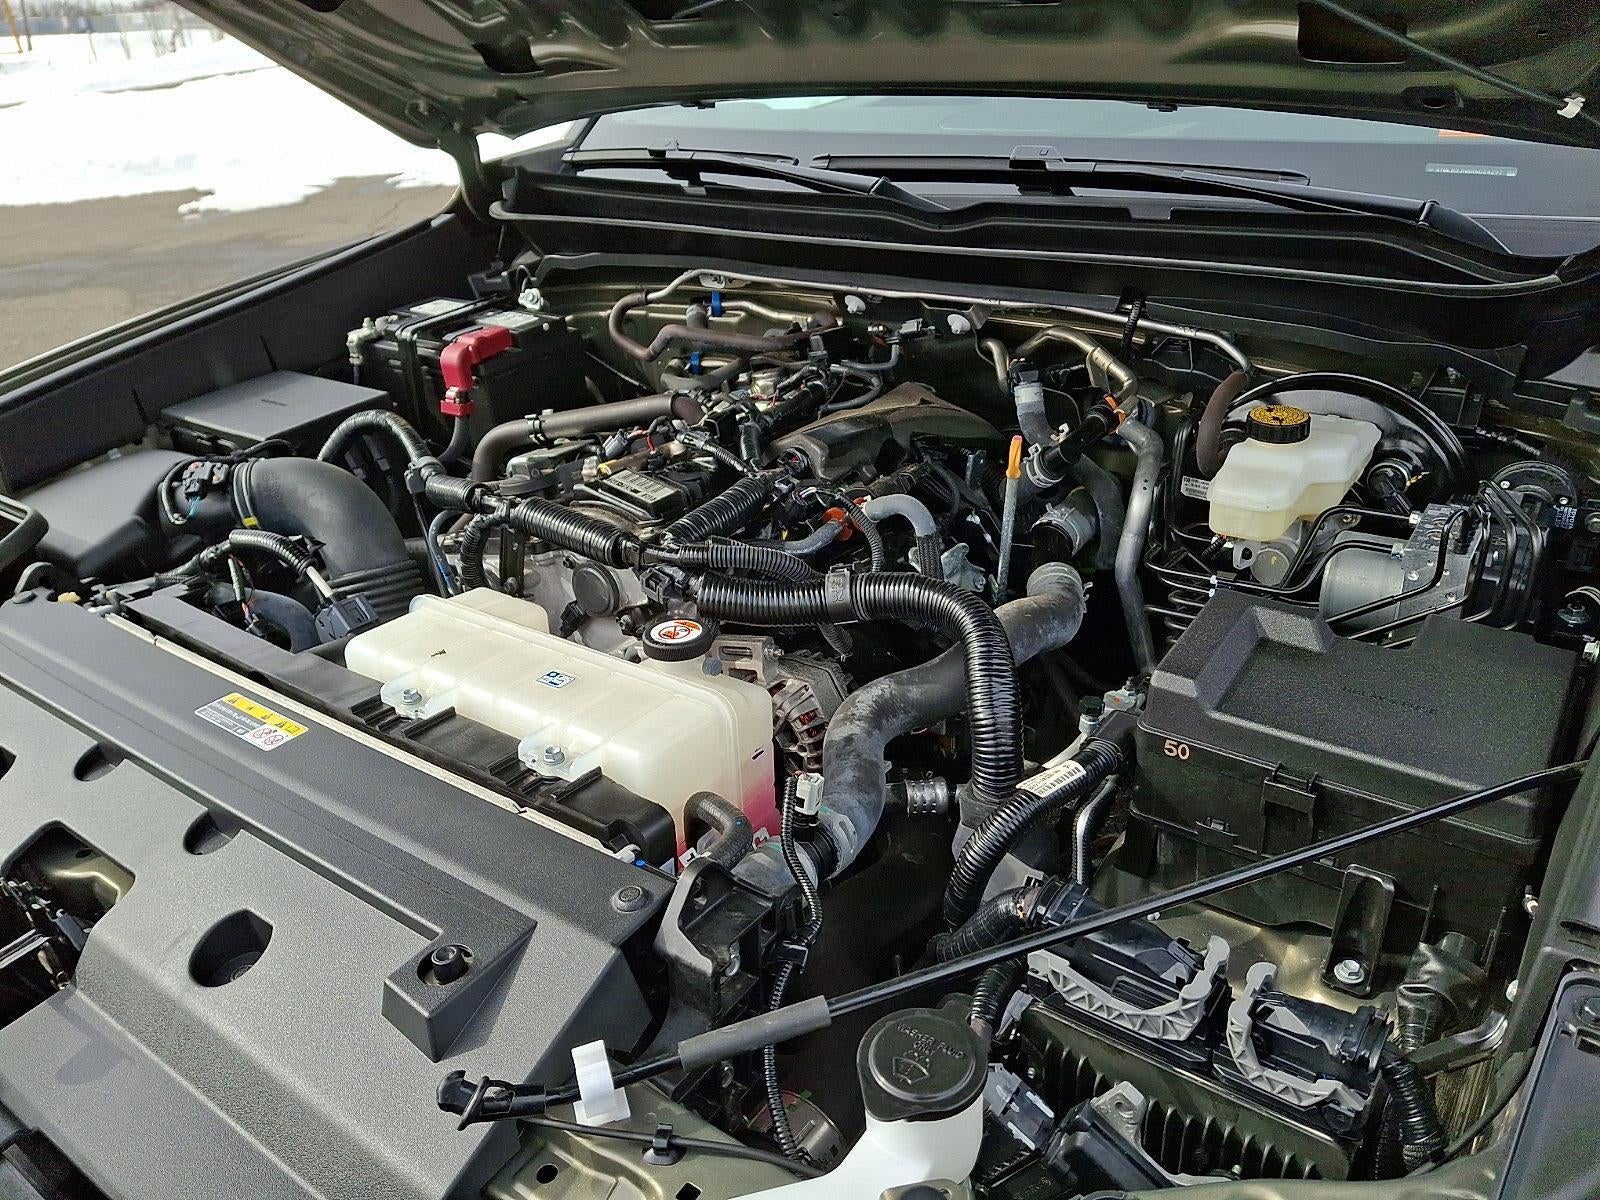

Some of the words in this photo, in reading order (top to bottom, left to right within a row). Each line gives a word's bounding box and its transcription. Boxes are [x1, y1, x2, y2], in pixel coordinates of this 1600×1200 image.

[1164, 739, 1190, 760] 50
[897, 1023, 935, 1046] WASHER
[937, 1042, 965, 1059] FLUID
[913, 1041, 937, 1056] ONLY
